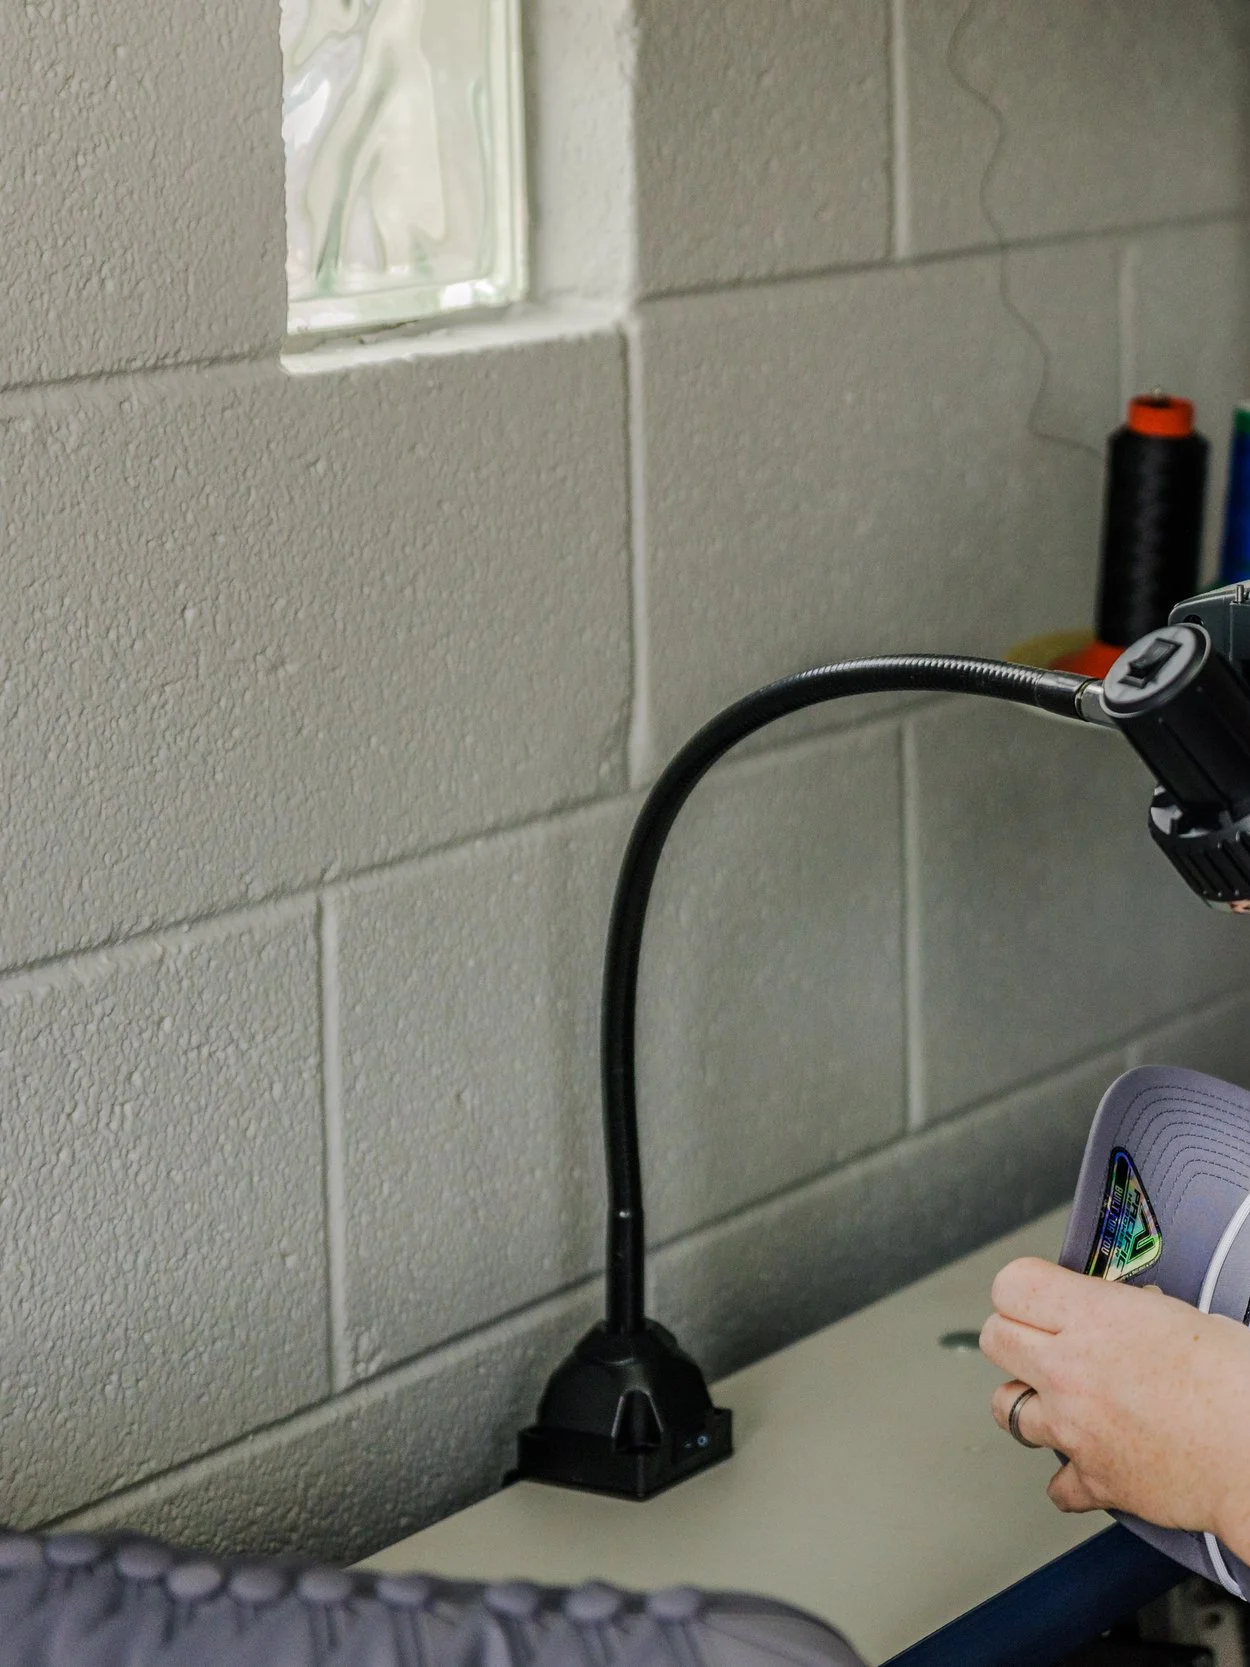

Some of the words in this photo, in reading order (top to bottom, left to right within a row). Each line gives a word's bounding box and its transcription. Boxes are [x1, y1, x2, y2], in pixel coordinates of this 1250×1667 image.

[1111, 1184, 1123, 1212] BUILT
[1106, 1211, 1119, 1232] FOR
[1115, 1192, 1133, 1257] HEADWEAR
[1116, 1188, 1141, 1272] PACIFIC
[1101, 1236, 1113, 1256] YOU
